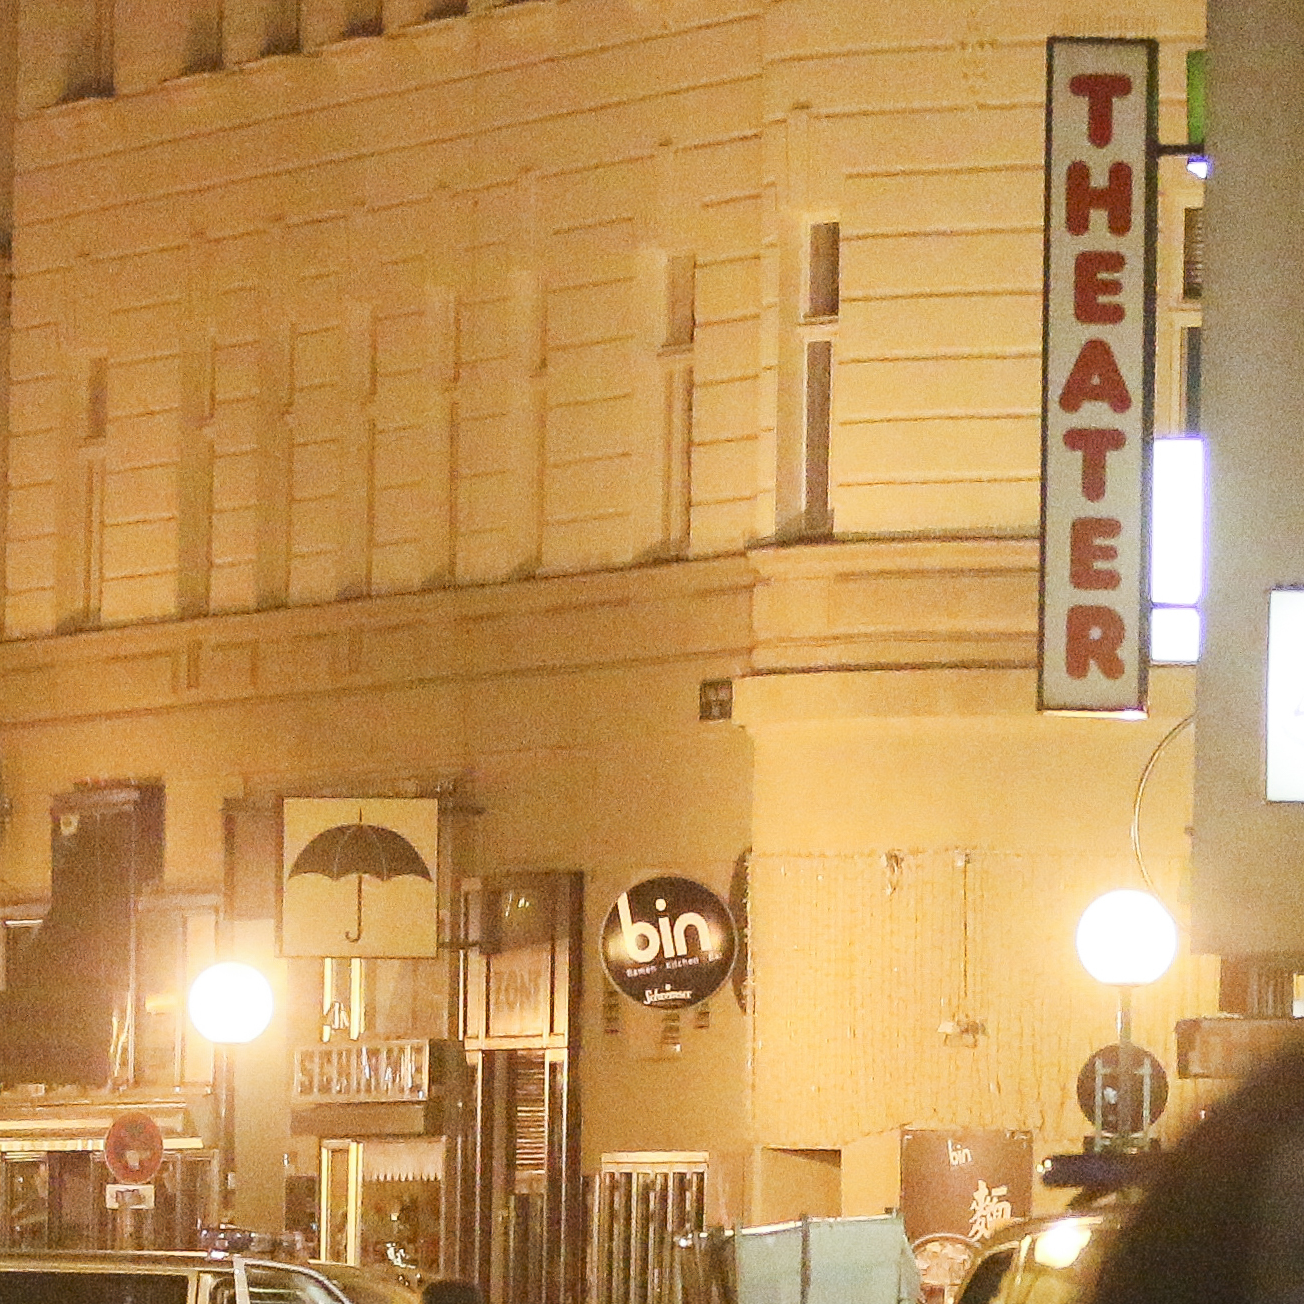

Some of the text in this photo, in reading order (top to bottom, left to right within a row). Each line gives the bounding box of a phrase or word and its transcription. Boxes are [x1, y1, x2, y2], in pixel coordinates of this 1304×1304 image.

[1058, 72, 1133, 681] THEATER
[617, 892, 712, 963] bin
[665, 957, 700, 970] Kitchen
[947, 1138, 973, 1166] bin
